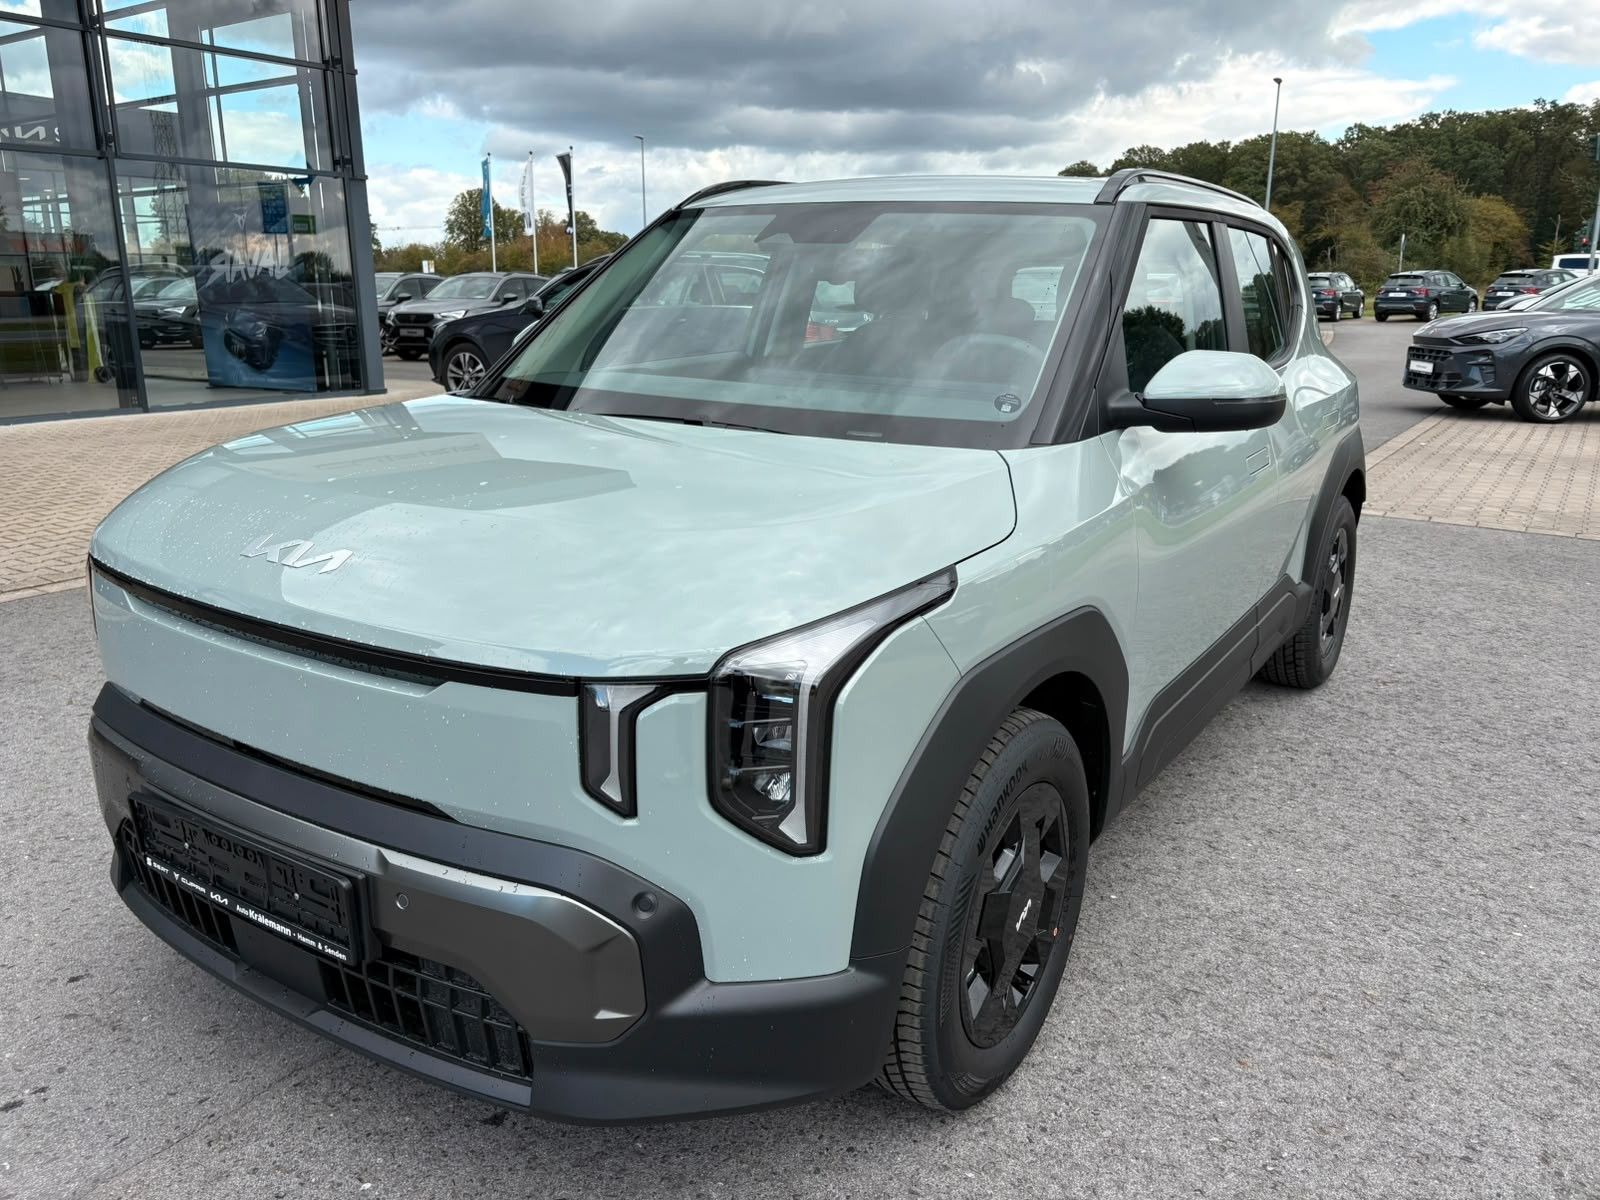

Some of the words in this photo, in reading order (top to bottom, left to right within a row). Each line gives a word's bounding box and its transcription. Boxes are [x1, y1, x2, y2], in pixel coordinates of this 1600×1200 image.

[239, 533, 354, 575] KIA
[209, 891, 229, 906] KIA
[236, 904, 249, 916] Auto
[297, 932, 317, 948] Hamm
[317, 941, 324, 951] &
[324, 944, 347, 961] Senden
